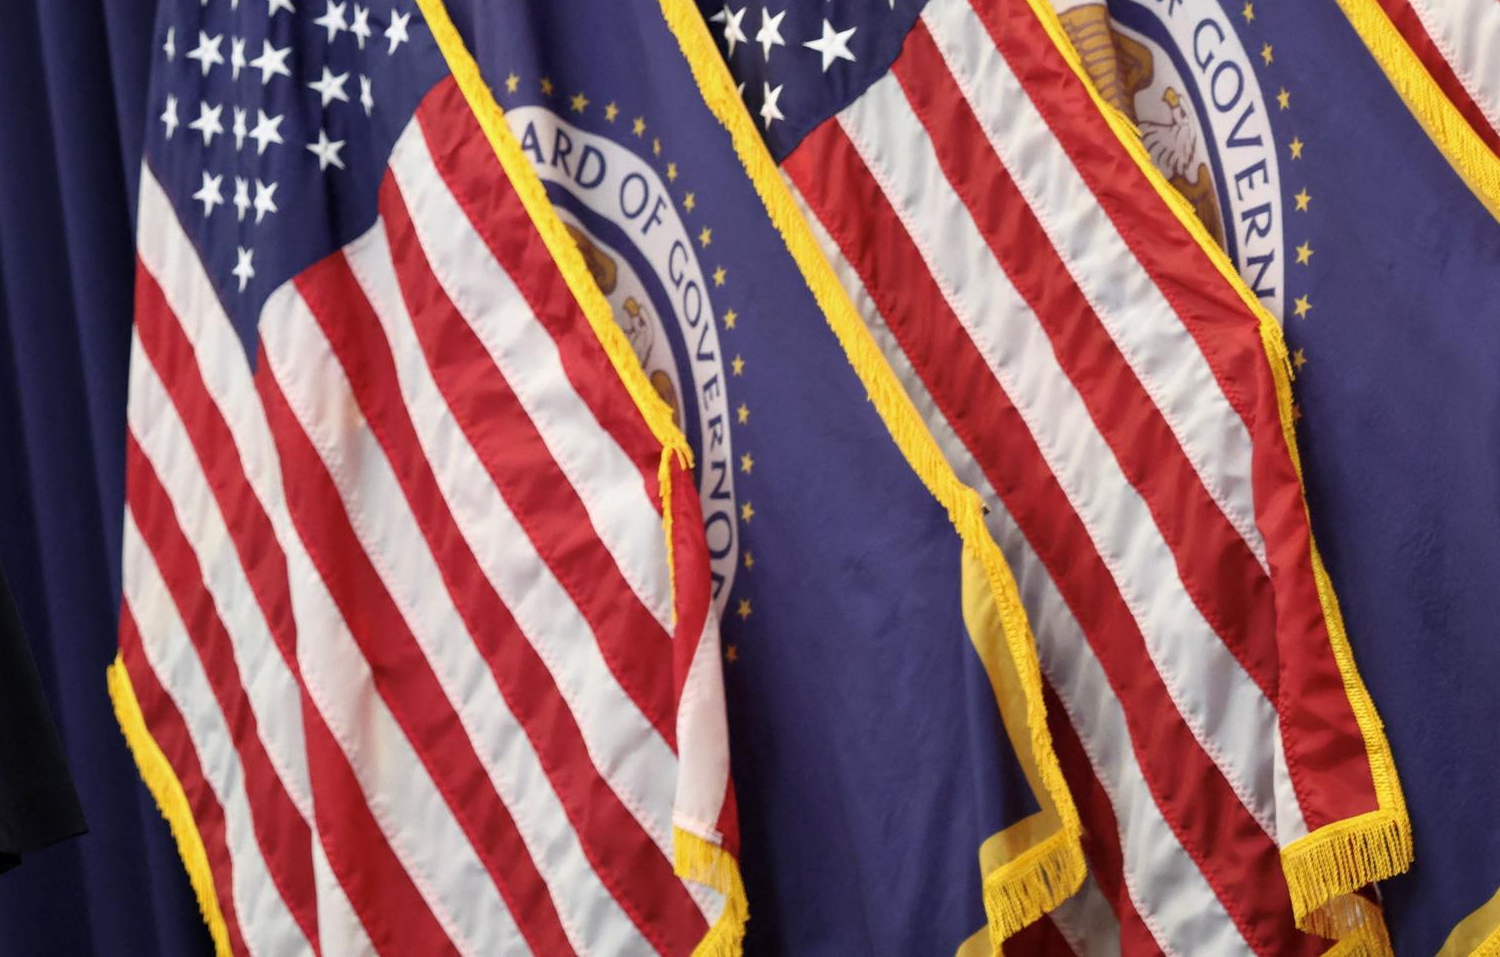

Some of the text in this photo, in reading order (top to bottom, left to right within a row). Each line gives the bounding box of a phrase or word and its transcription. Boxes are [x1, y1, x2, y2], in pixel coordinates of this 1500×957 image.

[1193, 18, 1276, 300] GOVERN
[521, 120, 733, 600] ARD OF GOVERNO
